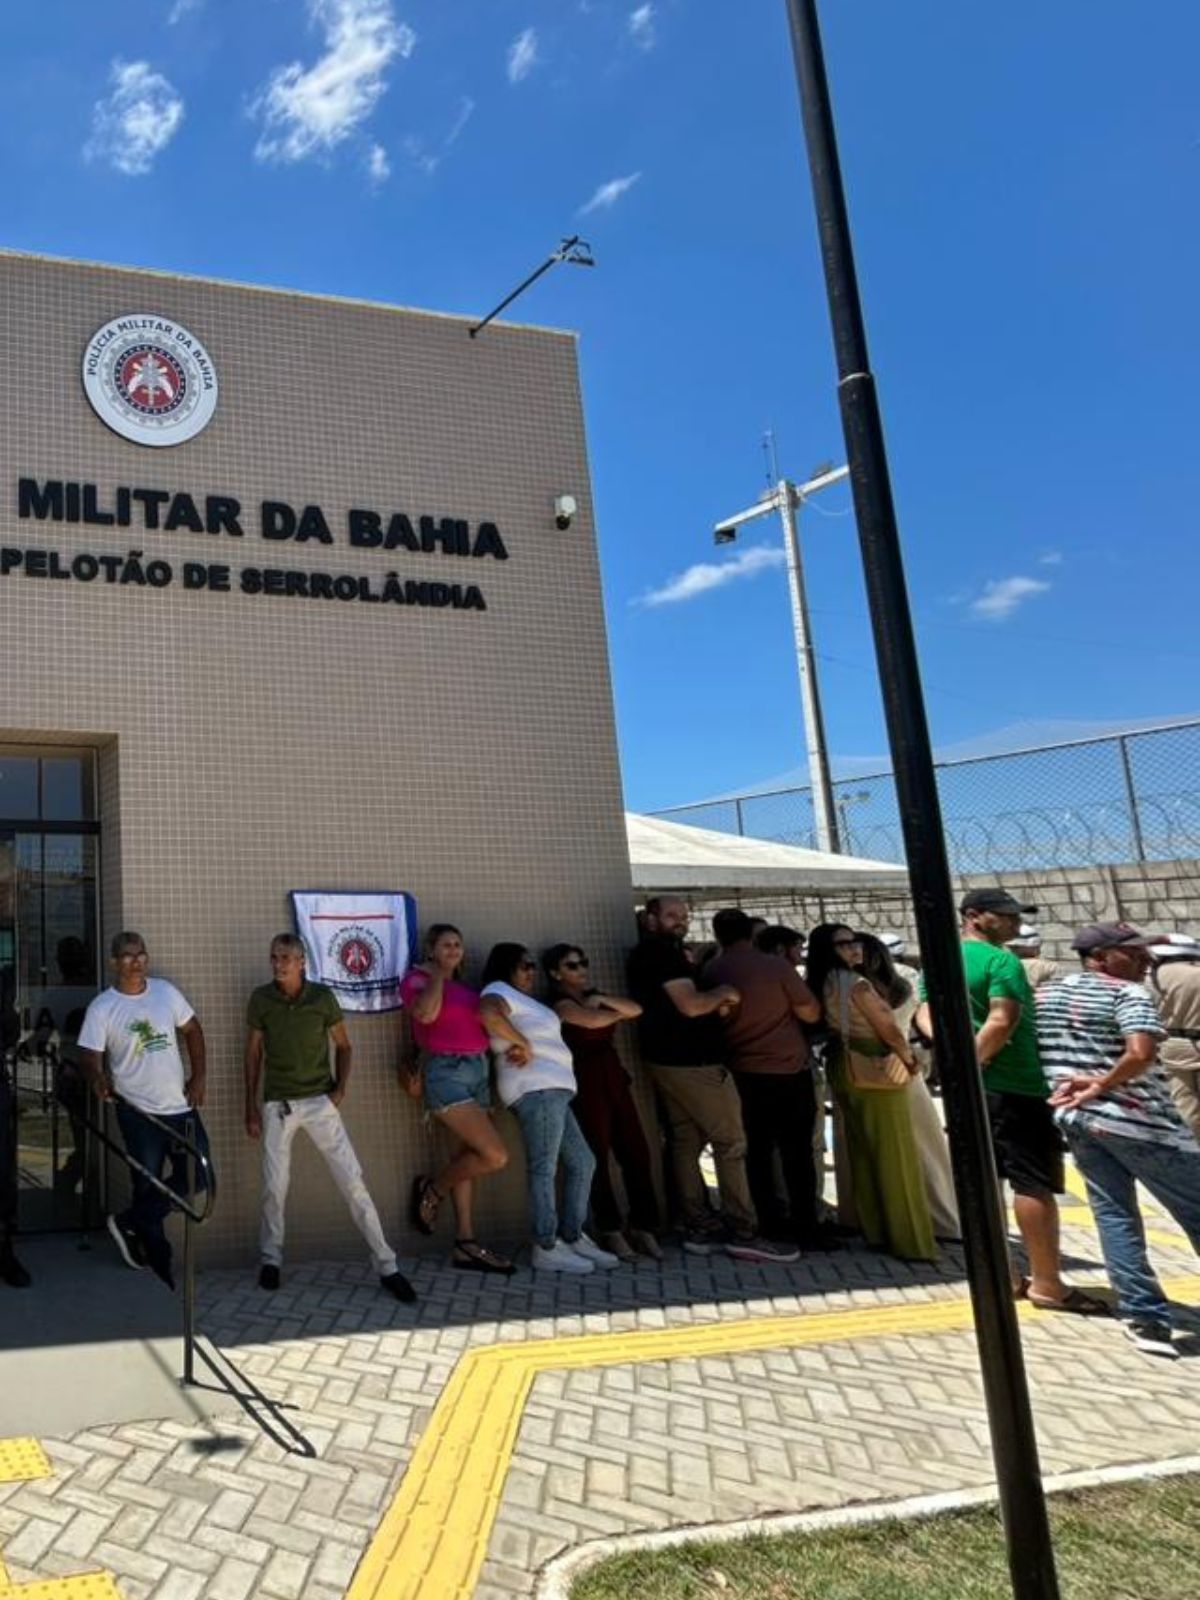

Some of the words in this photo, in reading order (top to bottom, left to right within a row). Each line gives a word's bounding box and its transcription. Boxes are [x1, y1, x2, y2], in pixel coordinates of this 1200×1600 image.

[117, 319, 173, 335] MILITAR
[176, 331, 192, 349] DA
[193, 350, 214, 390] BAHIA
[18, 477, 243, 537] MILITAR
[261, 500, 333, 544] DA
[349, 508, 509, 560] BAHIA
[0, 547, 172, 588] PELOTÃO
[183, 562, 231, 592] DE
[240, 566, 487, 611] SERROLÂNDIA
